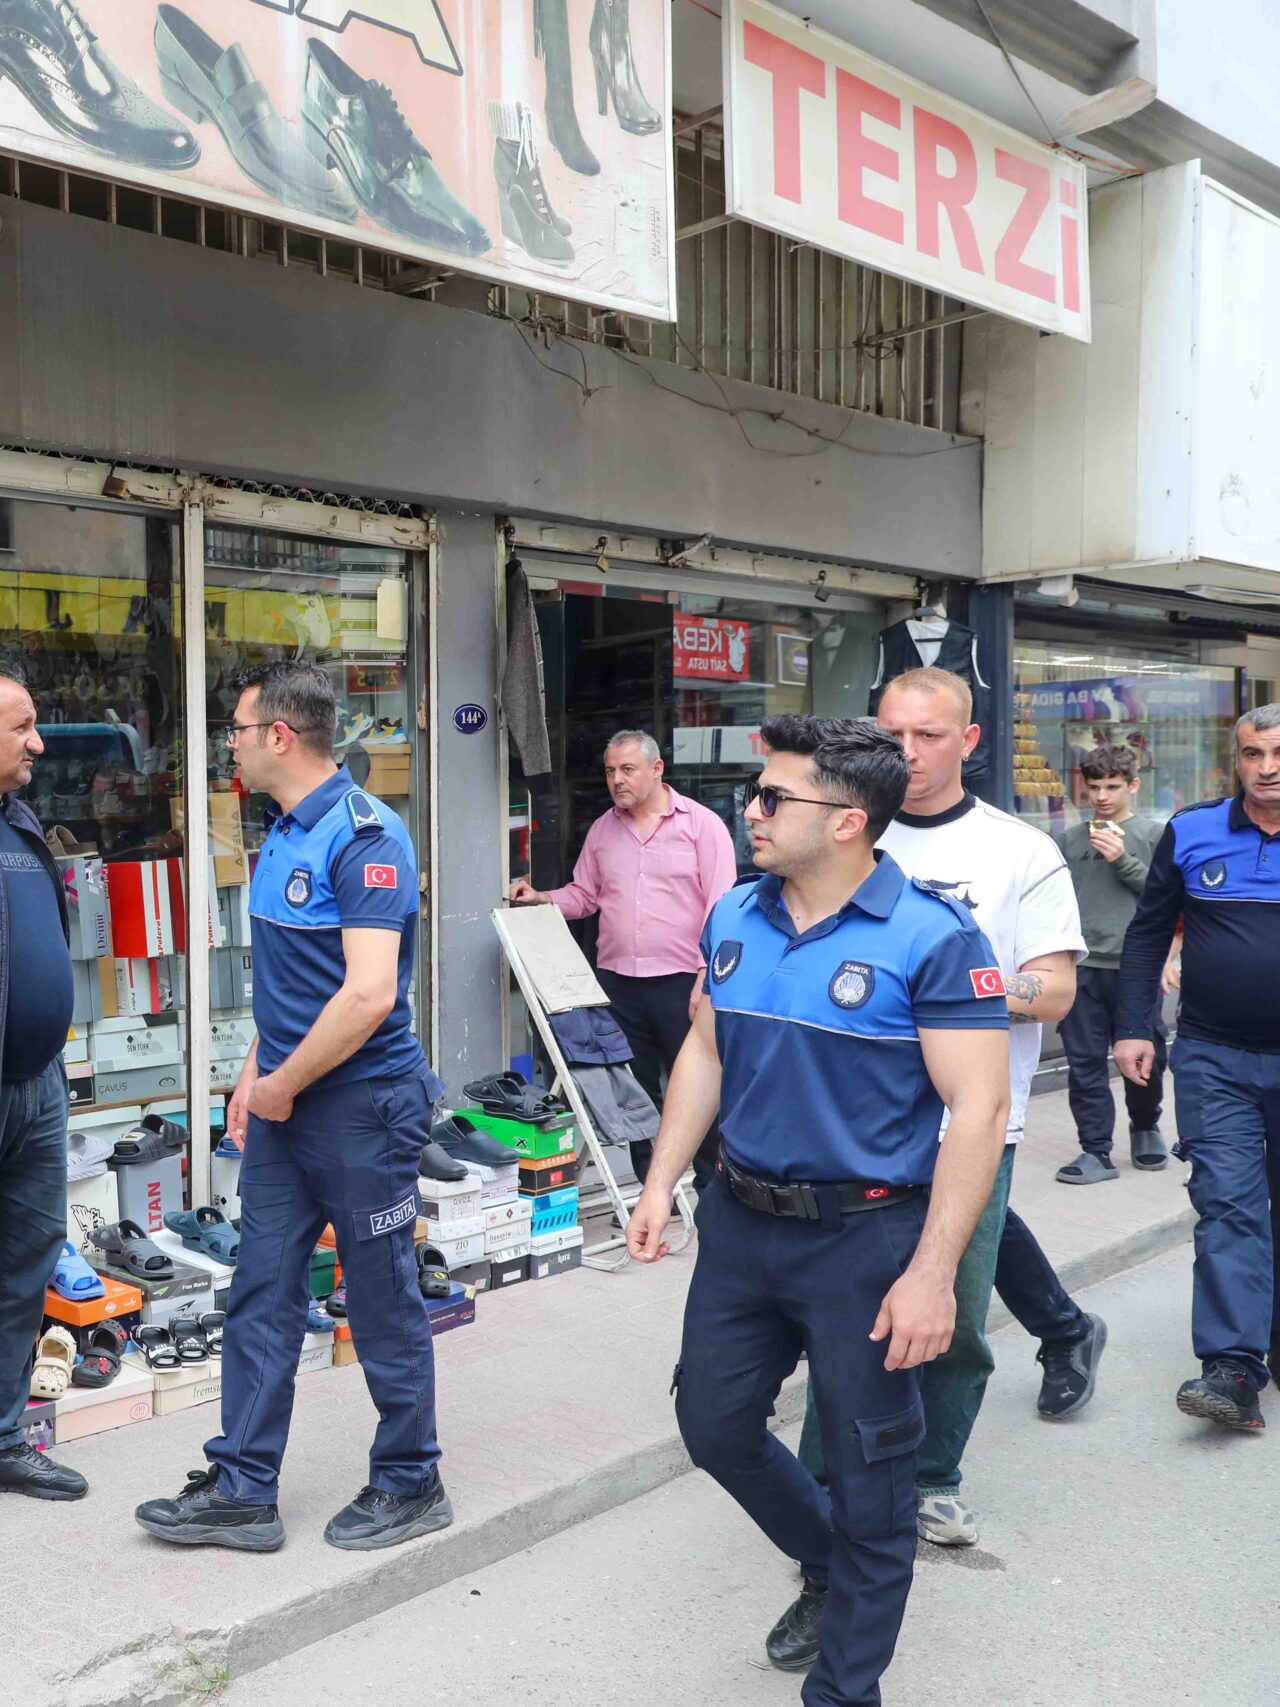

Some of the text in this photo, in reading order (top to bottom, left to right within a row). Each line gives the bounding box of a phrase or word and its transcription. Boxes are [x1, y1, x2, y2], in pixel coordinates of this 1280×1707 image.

[0, 854, 42, 868] URPOS
[844, 962, 869, 975] ZABITA
[374, 1202, 416, 1231] ZABITA
